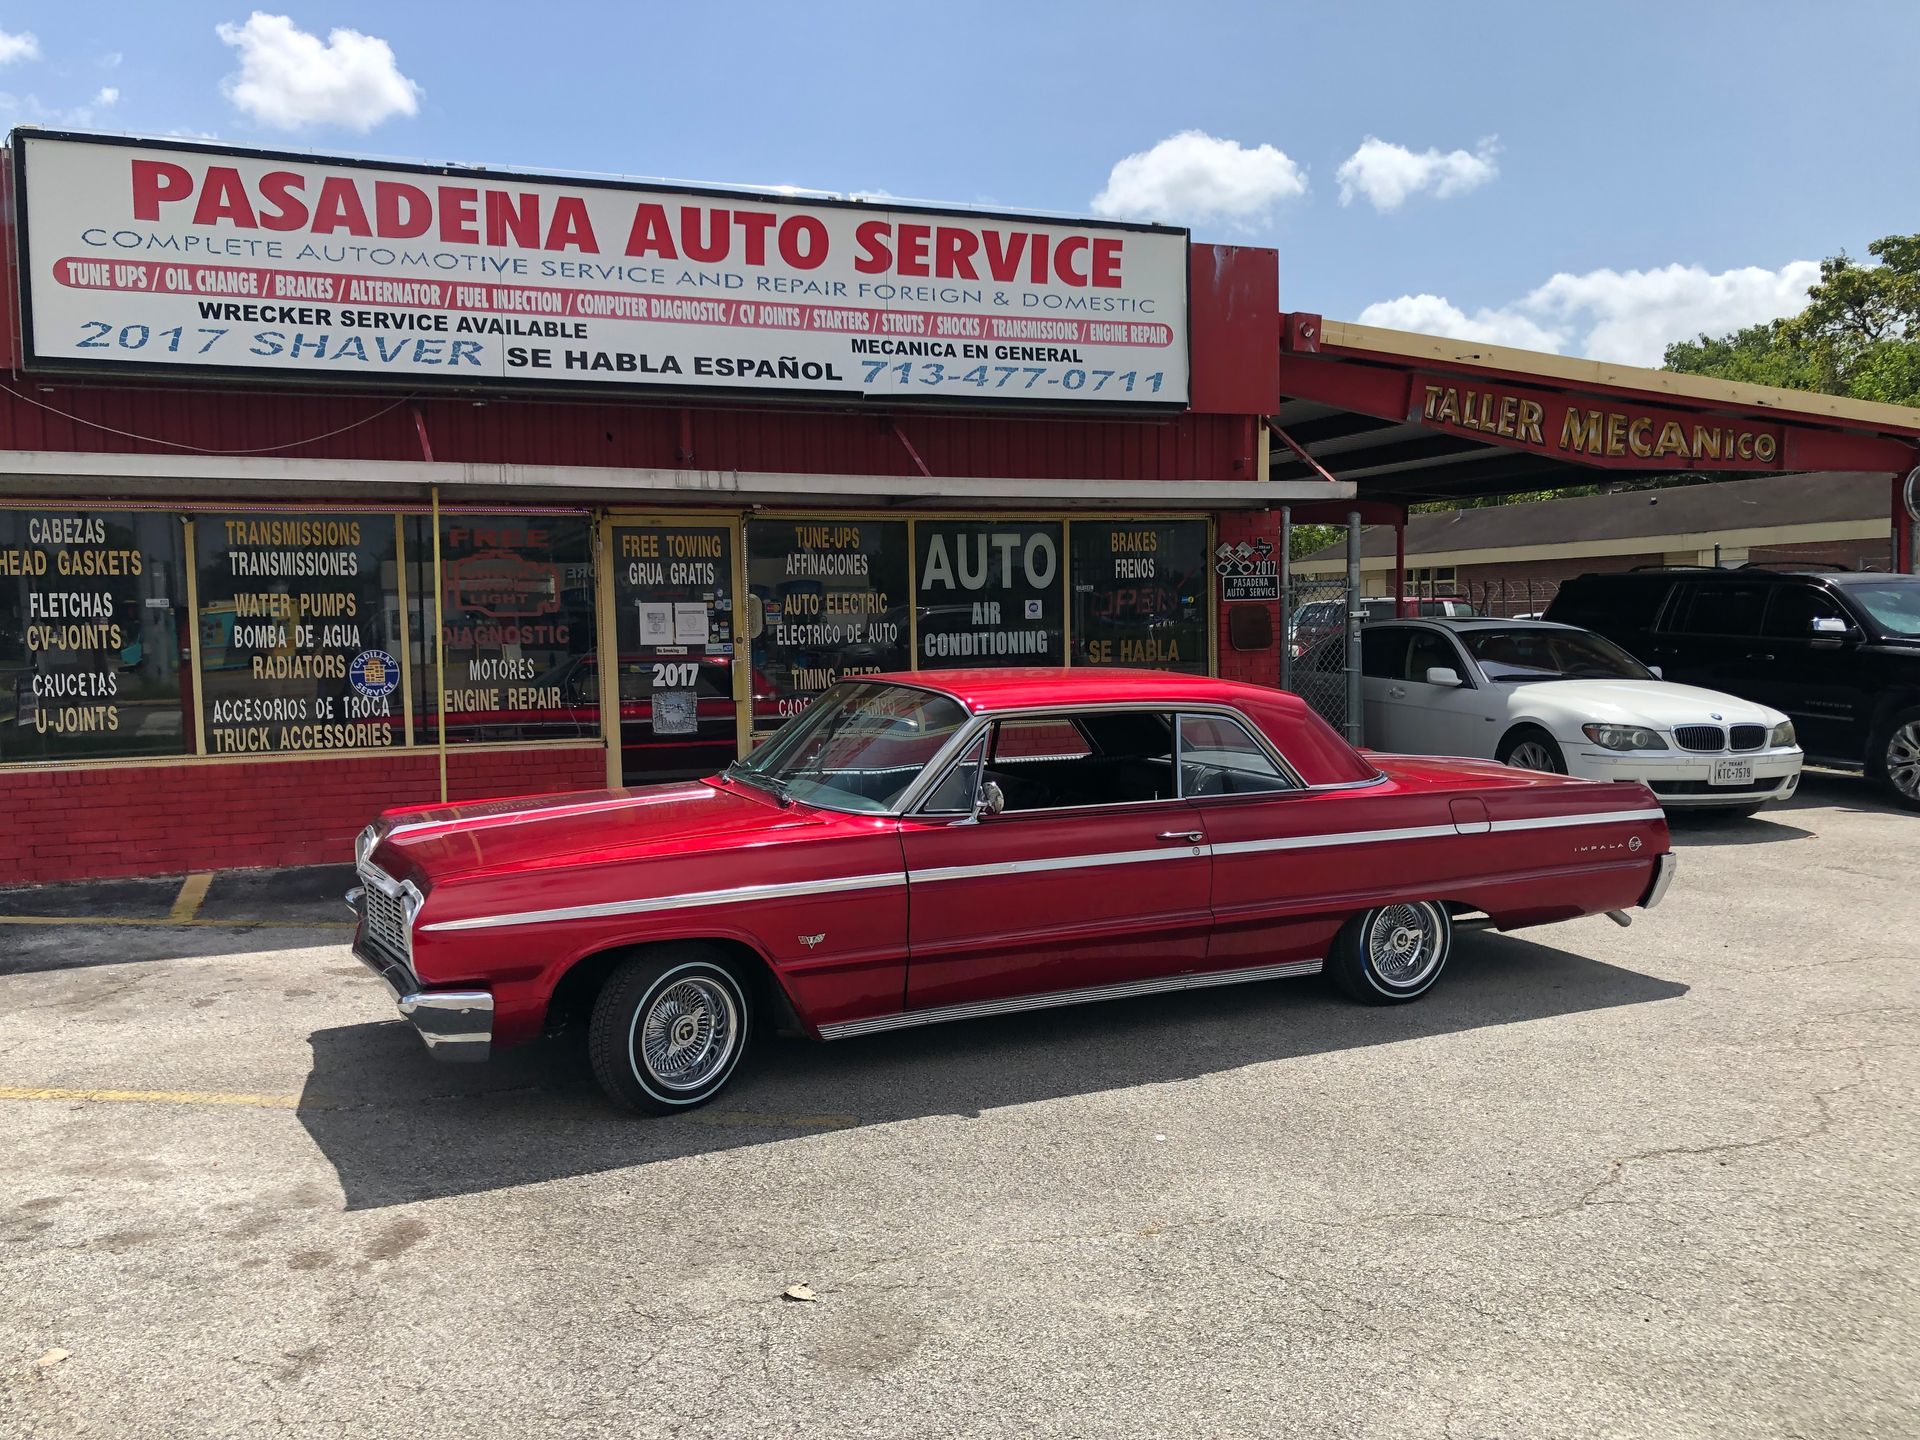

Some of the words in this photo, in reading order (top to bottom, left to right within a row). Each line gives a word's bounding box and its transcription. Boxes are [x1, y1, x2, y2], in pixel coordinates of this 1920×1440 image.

[132, 160, 600, 253] PASADENA
[625, 203, 829, 270] AUTO
[854, 221, 1123, 288] SERVICE
[81, 229, 282, 258] COMPLETE
[296, 244, 528, 274] AUTOMOTIVE
[541, 260, 665, 285] SERVICE
[676, 271, 744, 289] AND
[757, 276, 848, 297] REPAIR
[859, 284, 981, 304] FOREIGN
[993, 291, 1009, 305] &
[1023, 293, 1155, 314] DOMESTIC
[67, 262, 110, 287] TUNE
[115, 264, 147, 289] UPS
[165, 268, 192, 291] OIL
[196, 269, 258, 295] CHANGE
[275, 274, 333, 299] BRAKES
[350, 279, 441, 306] ALTERNATOR
[456, 287, 489, 309] FUEL
[493, 288, 562, 313] INJECTION
[576, 294, 648, 318] COMPUTER
[651, 299, 726, 322] DIAGNOSTIC
[739, 304, 756, 324] CV
[759, 306, 800, 326] JOINTS
[813, 309, 870, 331] STARTERS
[882, 313, 924, 334] STRUTS
[937, 317, 980, 337] SHOCKS
[992, 319, 1079, 340] TRANSMISSIONS
[1090, 323, 1128, 343] ENGINE
[1131, 325, 1168, 344] REPAIR
[198, 301, 332, 326] WRECKER
[340, 310, 448, 332] SERVICE
[456, 316, 588, 339] AVAILABLE
[75, 321, 229, 354] 2017
[249, 331, 484, 366] SHAVER
[851, 338, 957, 358] MECANICA
[963, 344, 988, 359] EN
[995, 345, 1083, 363] GENERAL
[507, 348, 551, 368] SE
[565, 350, 682, 374] HABLA
[694, 356, 843, 381] ESPAÑOL
[861, 360, 1164, 393] 713-477-0711
[1424, 385, 1544, 445] TALLER
[29, 518, 106, 544] CABEZAS
[225, 520, 361, 546] TRANSMISSIONS
[795, 527, 860, 549] TUNE-UPS
[1111, 531, 1157, 552] BRAKES
[622, 535, 659, 558] FREE
[666, 535, 722, 558] TOWING
[0, 550, 47, 576] HEAD
[57, 550, 142, 576] GASKETS
[229, 551, 358, 576] TRANSMISSIONES
[629, 562, 664, 585] GRUA
[670, 562, 715, 585] GRATIS
[786, 553, 868, 576] AFFINACIONES
[921, 532, 1057, 590] AUTO
[1115, 558, 1155, 579] FRENOS
[1256, 561, 1276, 575] 2017
[1226, 588, 1245, 597] AUTO
[1250, 587, 1275, 597] SERVICE
[1233, 577, 1269, 587] PASADENA
[29, 592, 113, 618] FLETCHAS
[234, 594, 290, 617] WATER
[300, 593, 356, 617] PUMPS
[784, 593, 819, 615] AUTO
[827, 592, 888, 615] ELECTRIC
[972, 601, 1001, 625] AIR
[26, 624, 122, 651] CV-JOINTS
[234, 625, 287, 649] BOMBA
[295, 624, 313, 648] DE
[323, 624, 361, 647] AGUA
[442, 624, 570, 645] DIAGNOSTIC
[776, 623, 840, 645] ELECTRICO
[847, 624, 861, 643] DE
[868, 622, 898, 643] AUTO
[924, 630, 1048, 657] CONDITIONING
[353, 651, 395, 669] CADILLAC
[1089, 640, 1112, 663] SE
[1121, 639, 1180, 662] HABLA
[253, 655, 346, 680] RADIATORS
[469, 658, 534, 681] MOTORES
[653, 663, 699, 687] 2017
[792, 668, 836, 690] TIMING
[32, 671, 117, 697] CRUCETAS
[356, 682, 395, 696] SERVICE
[213, 698, 306, 723] ACCESORIOS
[315, 696, 334, 720] DE
[343, 695, 390, 719] TROCA
[444, 688, 500, 713] ENGINE
[508, 687, 561, 710] REPAIR
[35, 705, 119, 734] U-JOINTS
[213, 727, 271, 752] TRUCK
[280, 722, 392, 750] ACCESSORIES
[1574, 843, 1623, 852] IMPALA
